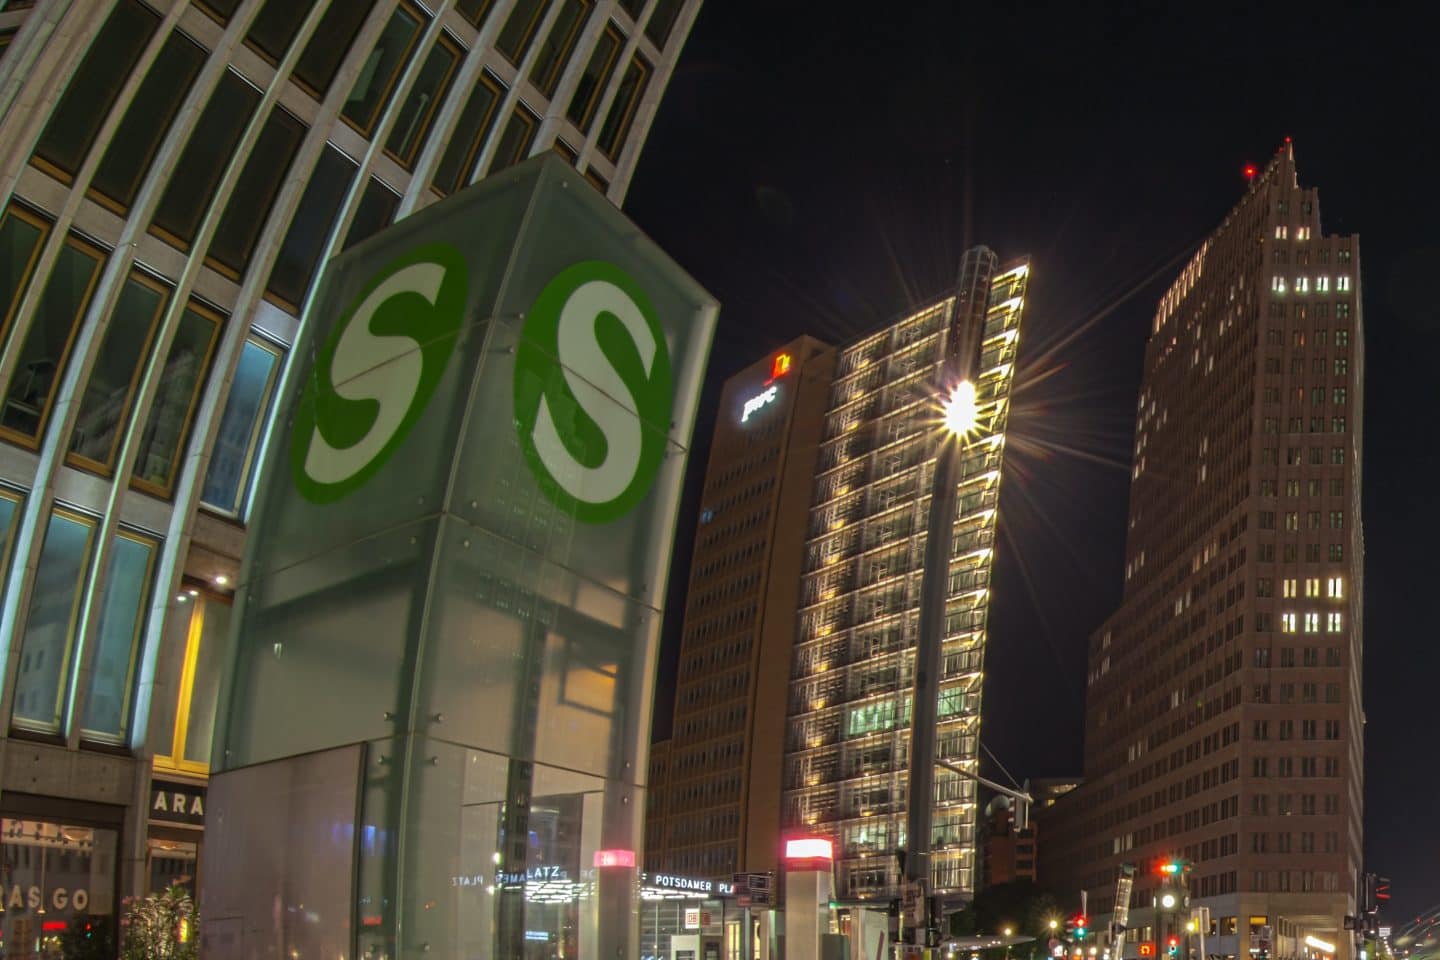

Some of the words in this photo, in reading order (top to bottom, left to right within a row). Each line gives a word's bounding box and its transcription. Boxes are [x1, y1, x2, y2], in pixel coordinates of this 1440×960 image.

[305, 262, 446, 484] S
[533, 280, 657, 504] S
[527, 866, 559, 880] LATZ
[655, 874, 712, 892] POTSDAMER
